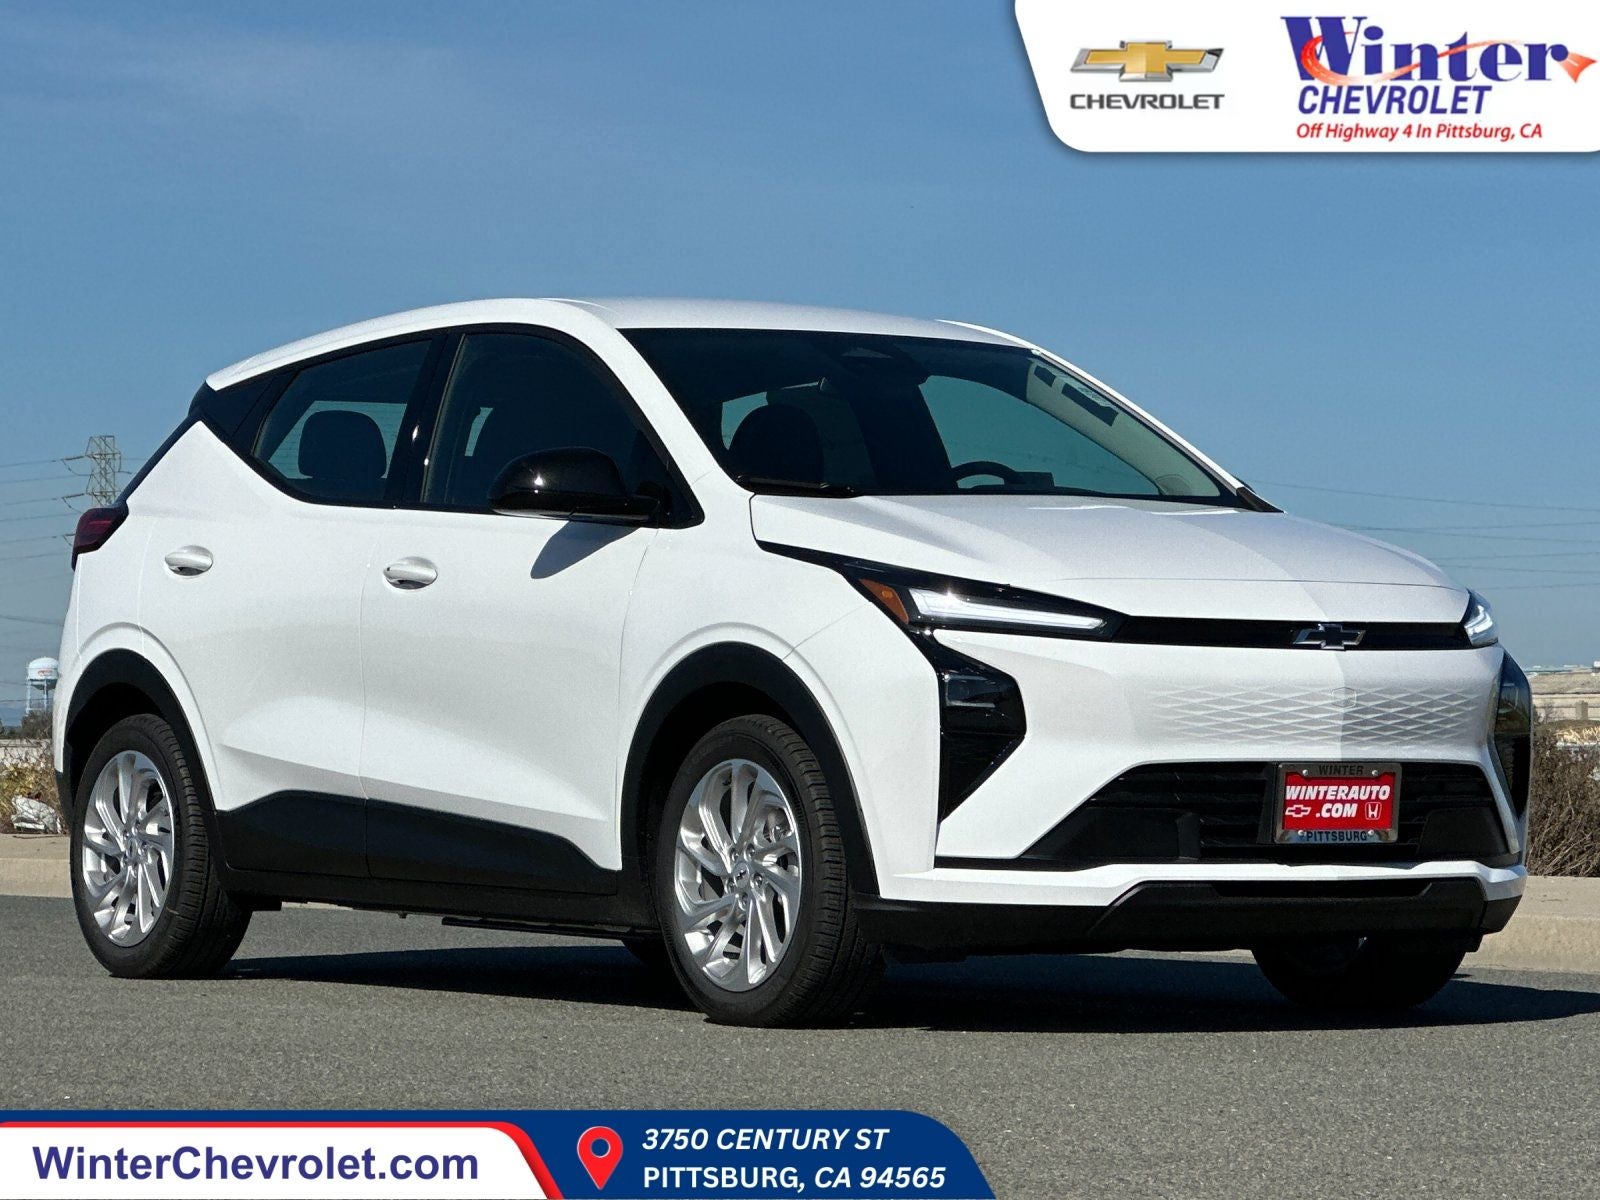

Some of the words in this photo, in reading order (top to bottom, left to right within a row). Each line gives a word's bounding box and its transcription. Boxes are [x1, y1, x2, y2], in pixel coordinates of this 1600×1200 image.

[1318, 765, 1364, 776] WINTER
[1285, 785, 1391, 800] WINTERAUTO
[1315, 803, 1358, 818] .COM
[1306, 831, 1367, 841] PITTSBURG
